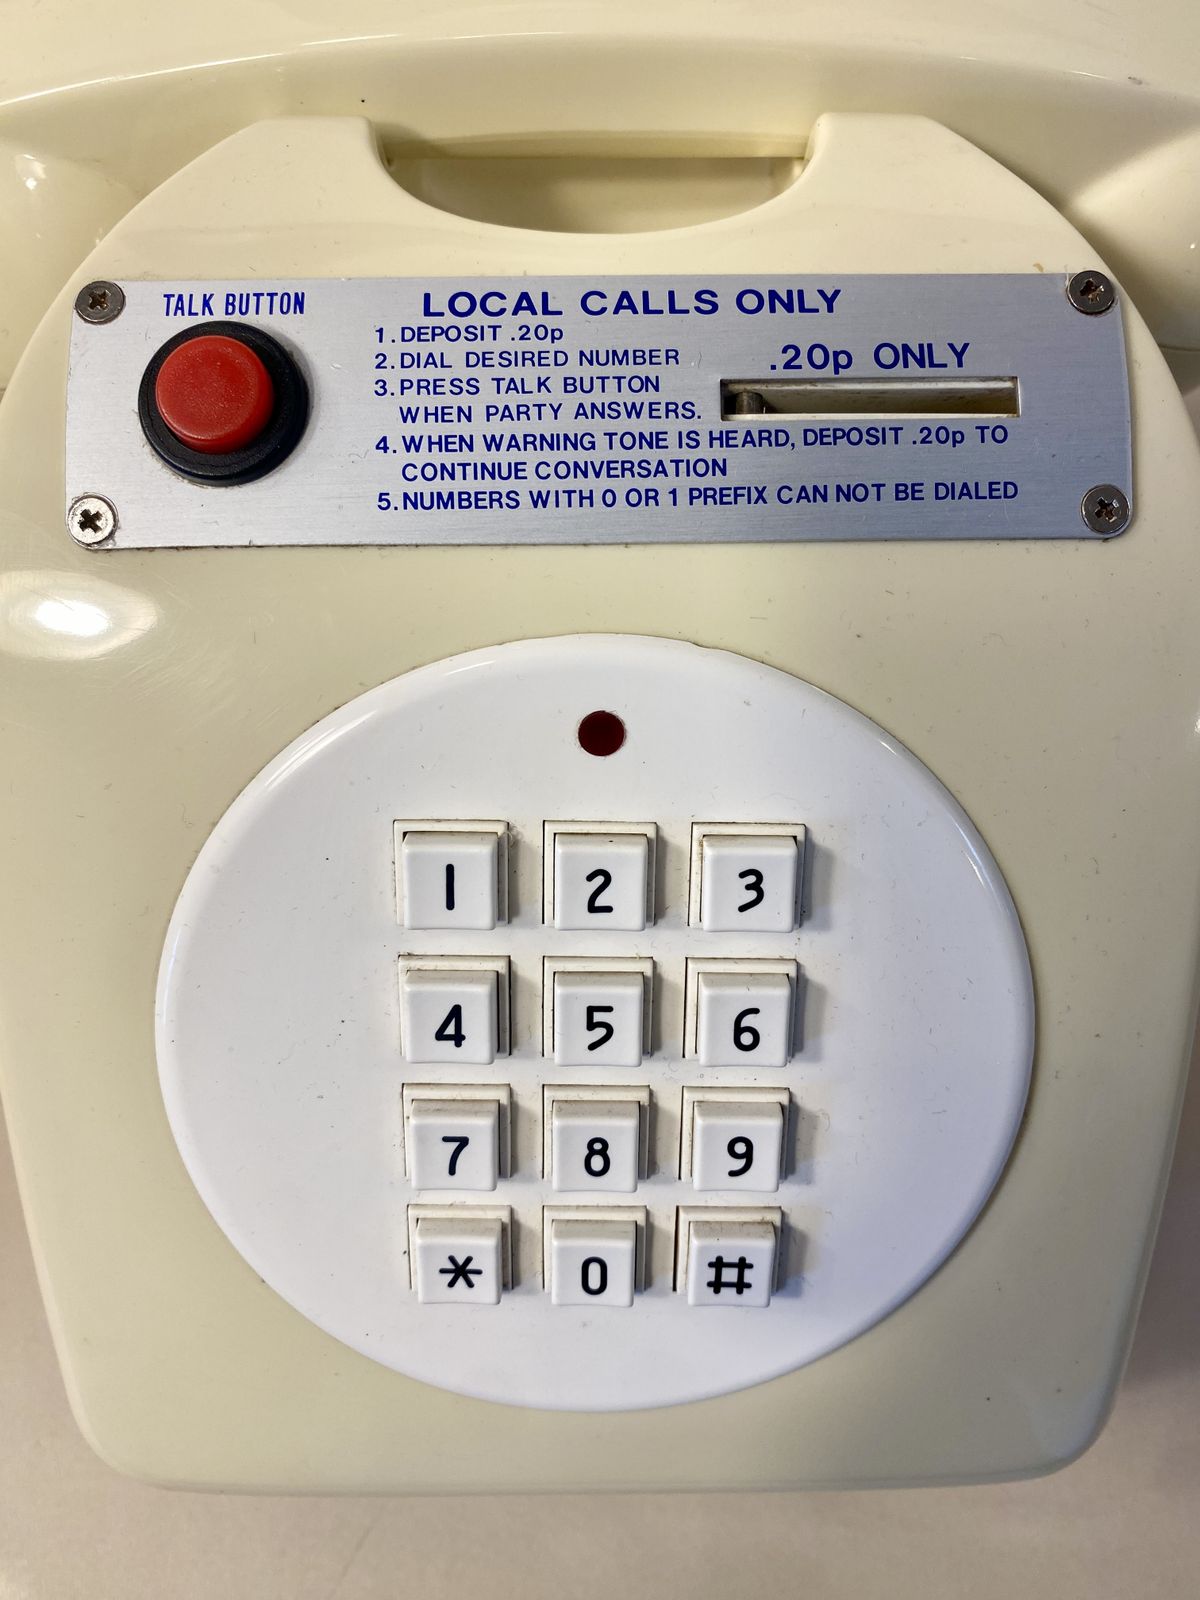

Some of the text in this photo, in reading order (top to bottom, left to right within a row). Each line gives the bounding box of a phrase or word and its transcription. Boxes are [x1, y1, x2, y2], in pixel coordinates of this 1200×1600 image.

[163, 291, 306, 317] TALK BUTTON
[423, 288, 842, 318] LOCAL CALLS ONLY
[400, 324, 502, 343] DEPOSIT
[511, 323, 564, 344] .20p
[400, 351, 452, 370] DIAL
[465, 349, 569, 369] DESIRED
[578, 348, 680, 367] NUMBER
[769, 341, 971, 376] .20p ONLY
[400, 377, 481, 396] PRESS
[491, 376, 552, 395] TALK
[563, 374, 660, 395] BUTTON
[399, 400, 701, 424] WHEN PARTY ANSWERS.
[401, 434, 475, 454] WHEN
[482, 431, 596, 453] WARNING
[603, 430, 669, 451] TONE
[677, 429, 701, 450] IS
[708, 428, 797, 451] HEARD,
[802, 426, 904, 447] DEPOSIT
[910, 425, 966, 449] .20p
[975, 424, 1009, 445] TO
[401, 457, 728, 482] CONTINUE CONVERSATION
[402, 489, 521, 511] NUMBERS
[528, 488, 595, 509] WITH
[601, 488, 617, 508] 0
[624, 487, 660, 508] OR
[667, 487, 678, 507] 1
[688, 485, 769, 507] PREFIX
[776, 483, 829, 505] CAN
[835, 482, 886, 504] NOT
[894, 481, 925, 502] BE
[934, 480, 1020, 501] DIALED
[445, 863, 455, 911] 1
[585, 868, 614, 914] 2
[737, 868, 765, 913] 3
[434, 1003, 467, 1048] 4
[585, 1005, 615, 1052] 5
[733, 1007, 761, 1052] 6
[441, 1135, 470, 1177] 7
[583, 1136, 611, 1178] 8
[726, 1135, 754, 1178] 9
[581, 1256, 608, 1296] 0
